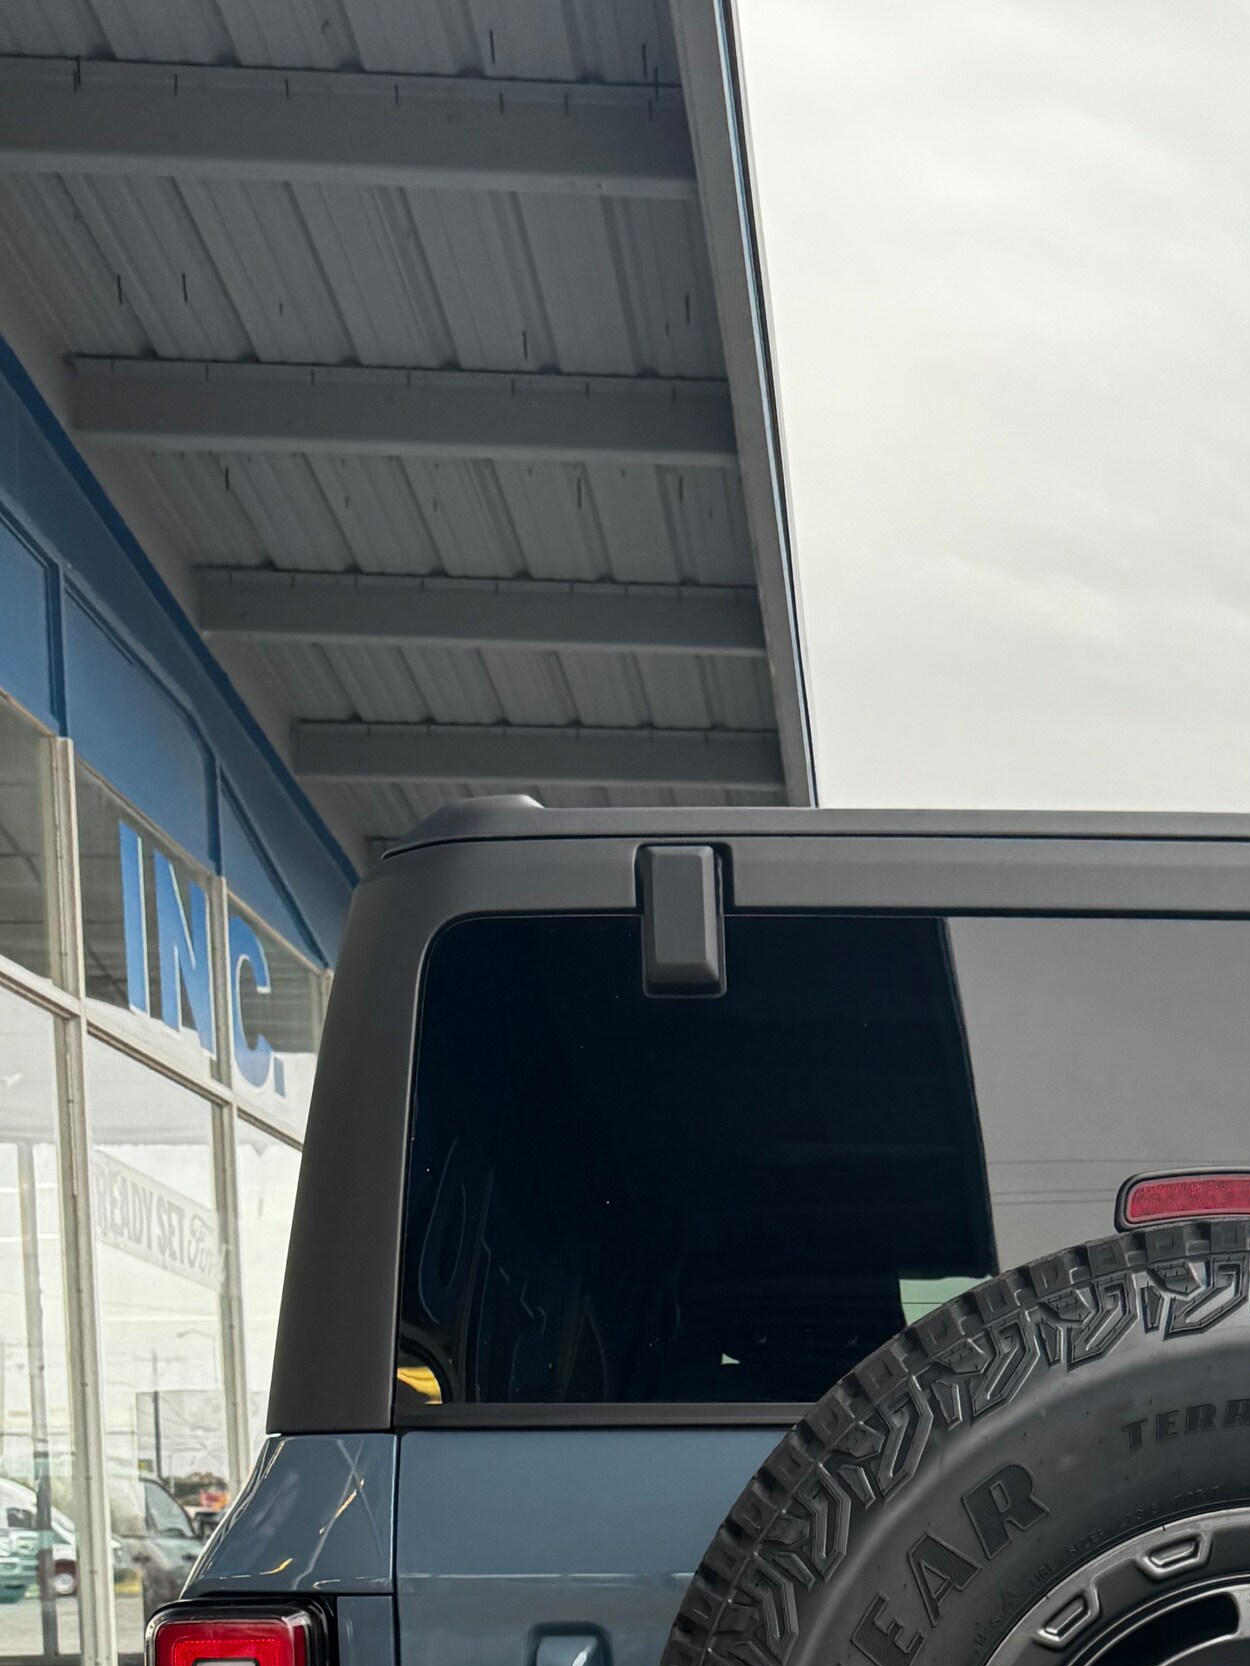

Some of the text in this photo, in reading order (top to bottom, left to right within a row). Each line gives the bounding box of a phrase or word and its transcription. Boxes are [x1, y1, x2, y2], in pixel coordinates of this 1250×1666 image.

[118, 819, 286, 1099] INC.
[94, 1163, 153, 1250] READY
[157, 1193, 186, 1265] SET
